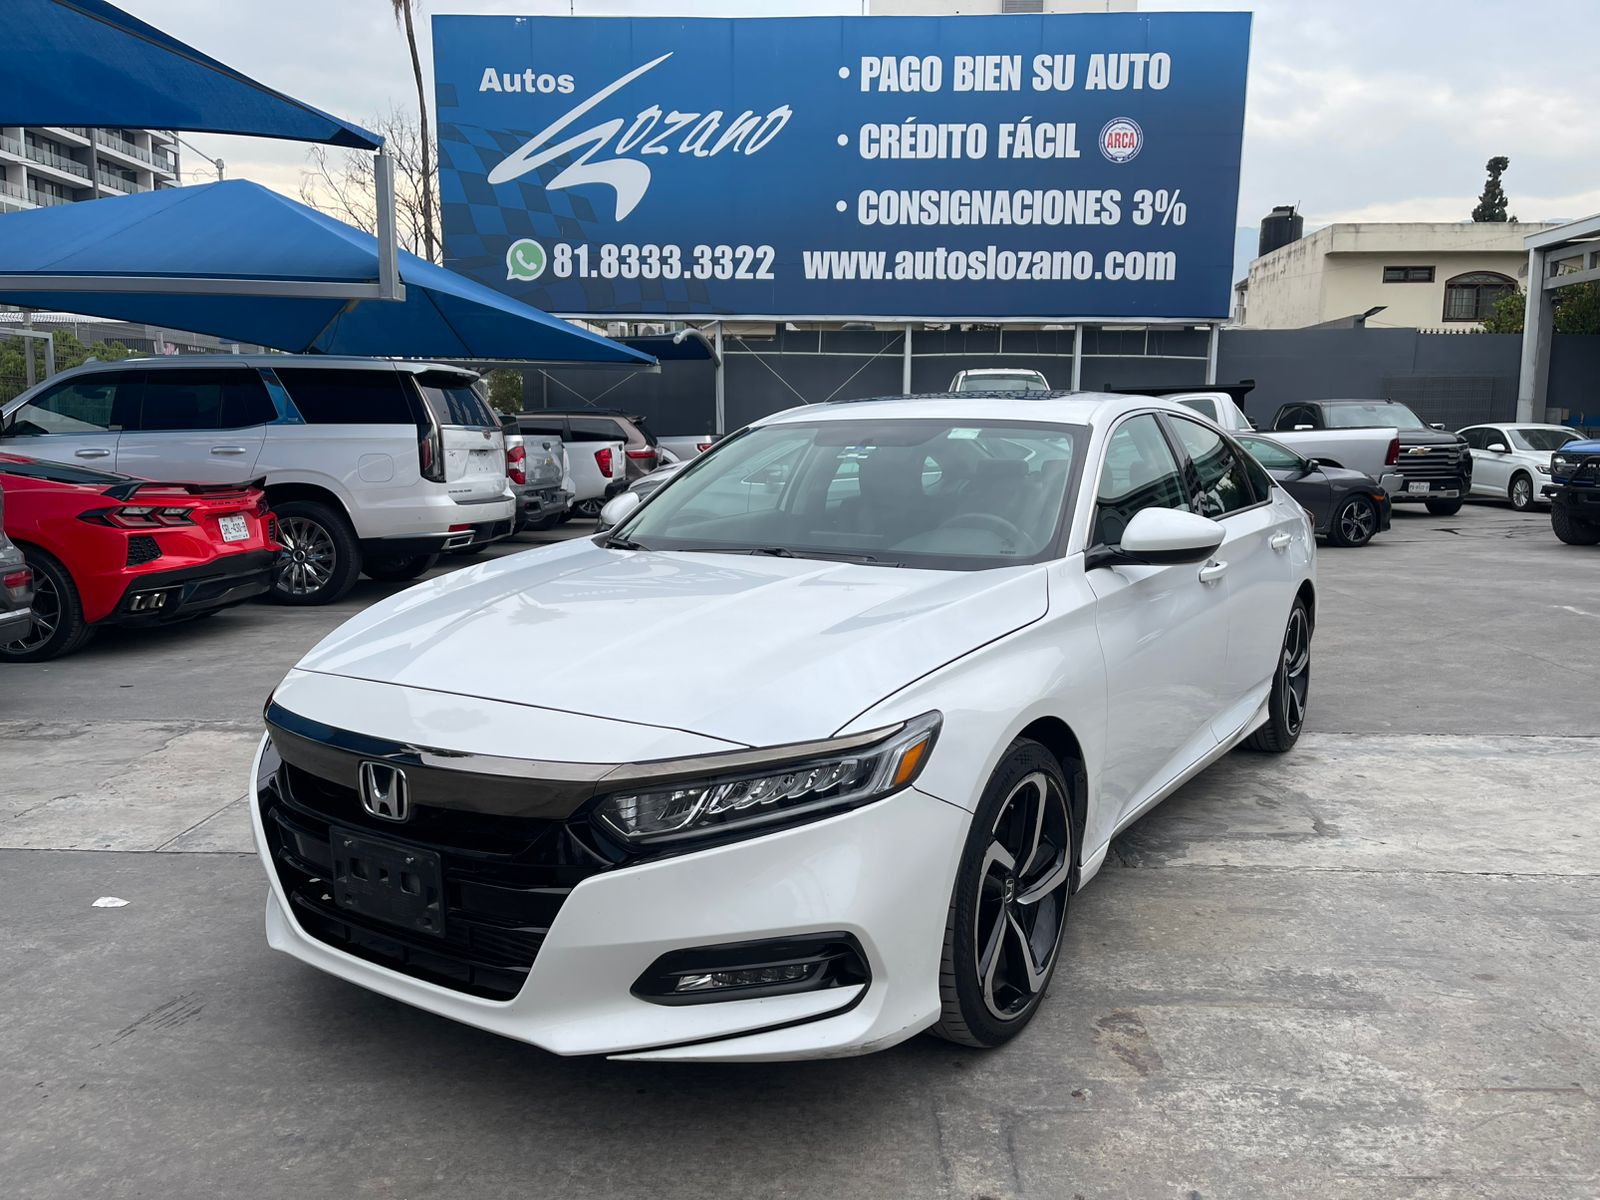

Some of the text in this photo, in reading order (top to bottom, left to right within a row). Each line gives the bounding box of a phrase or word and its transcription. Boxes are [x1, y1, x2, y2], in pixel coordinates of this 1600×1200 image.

[479, 68, 575, 94] Autos
[860, 52, 1171, 93] PAGO BIEN SU AUTO
[859, 116, 988, 160] CRÉDITO
[997, 115, 1081, 159] FÁCIL
[1106, 132, 1135, 149] ARCA
[858, 189, 1187, 226] CONSIGNACIONES 3%
[553, 243, 775, 280] 81.8333.3322
[802, 245, 1176, 281] www.autoslozano.com
